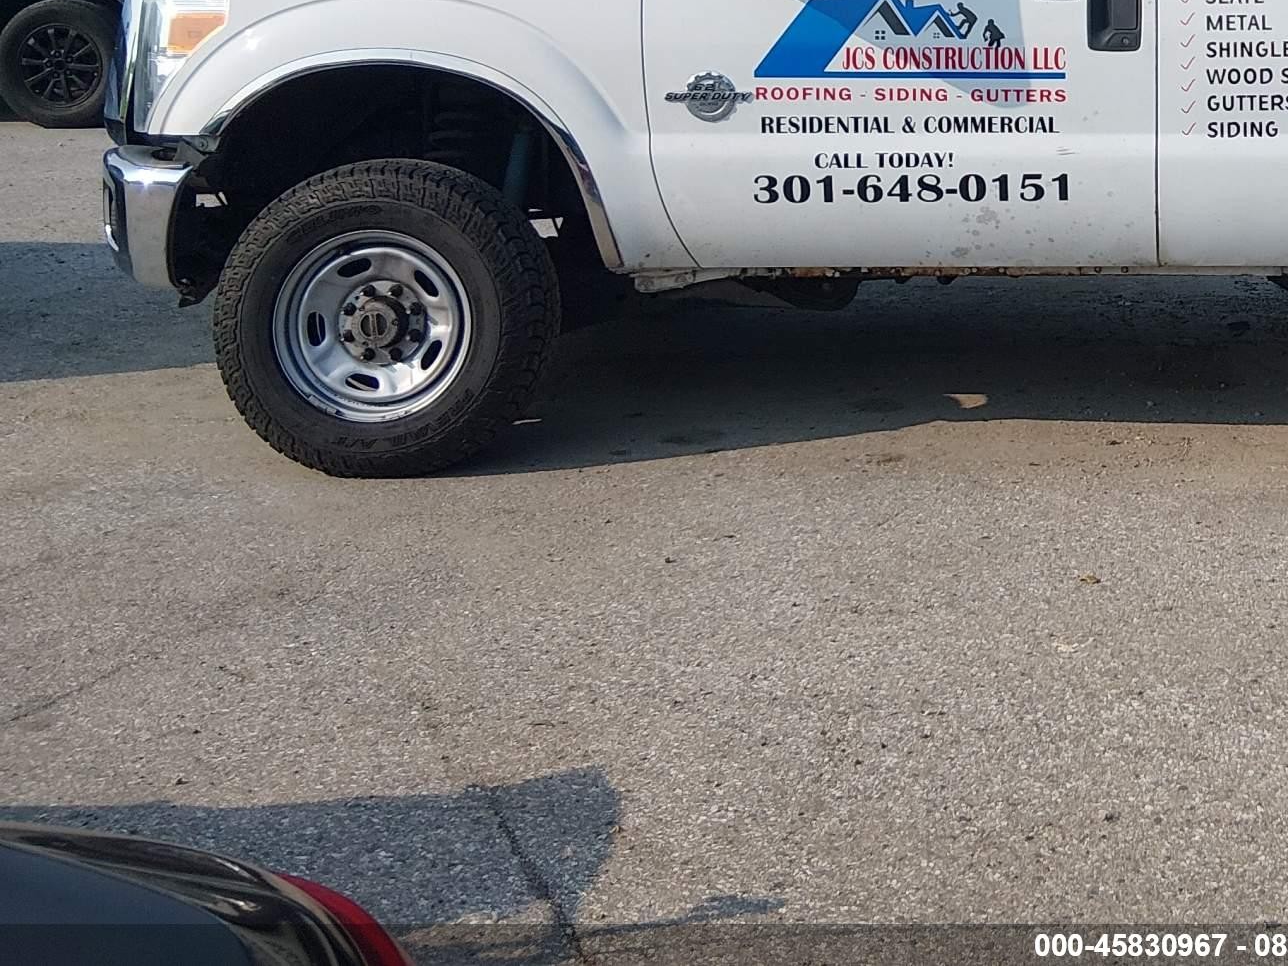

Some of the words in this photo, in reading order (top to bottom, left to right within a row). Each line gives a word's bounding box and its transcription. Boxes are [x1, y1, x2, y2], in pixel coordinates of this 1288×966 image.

[1206, 14, 1272, 31] METAL
[842, 47, 876, 70] JCS
[883, 47, 1025, 70] CONSTRUCTION
[1033, 47, 1066, 70] LLC
[1206, 68, 1273, 84] WOOD
[664, 92, 708, 102] SUPER
[711, 92, 751, 101] DUTY
[755, 87, 851, 101] ROOFING
[874, 87, 948, 101] SIDING
[970, 89, 1066, 103] GUTTERS
[761, 116, 895, 134] RESIDENTIAL
[901, 116, 916, 134] &
[923, 116, 1060, 134] COMMERCIAL
[1207, 121, 1278, 138] SIDING
[814, 152, 869, 169] CALL
[875, 152, 954, 168] TODAY!
[753, 173, 1070, 204] 301-648-0151
